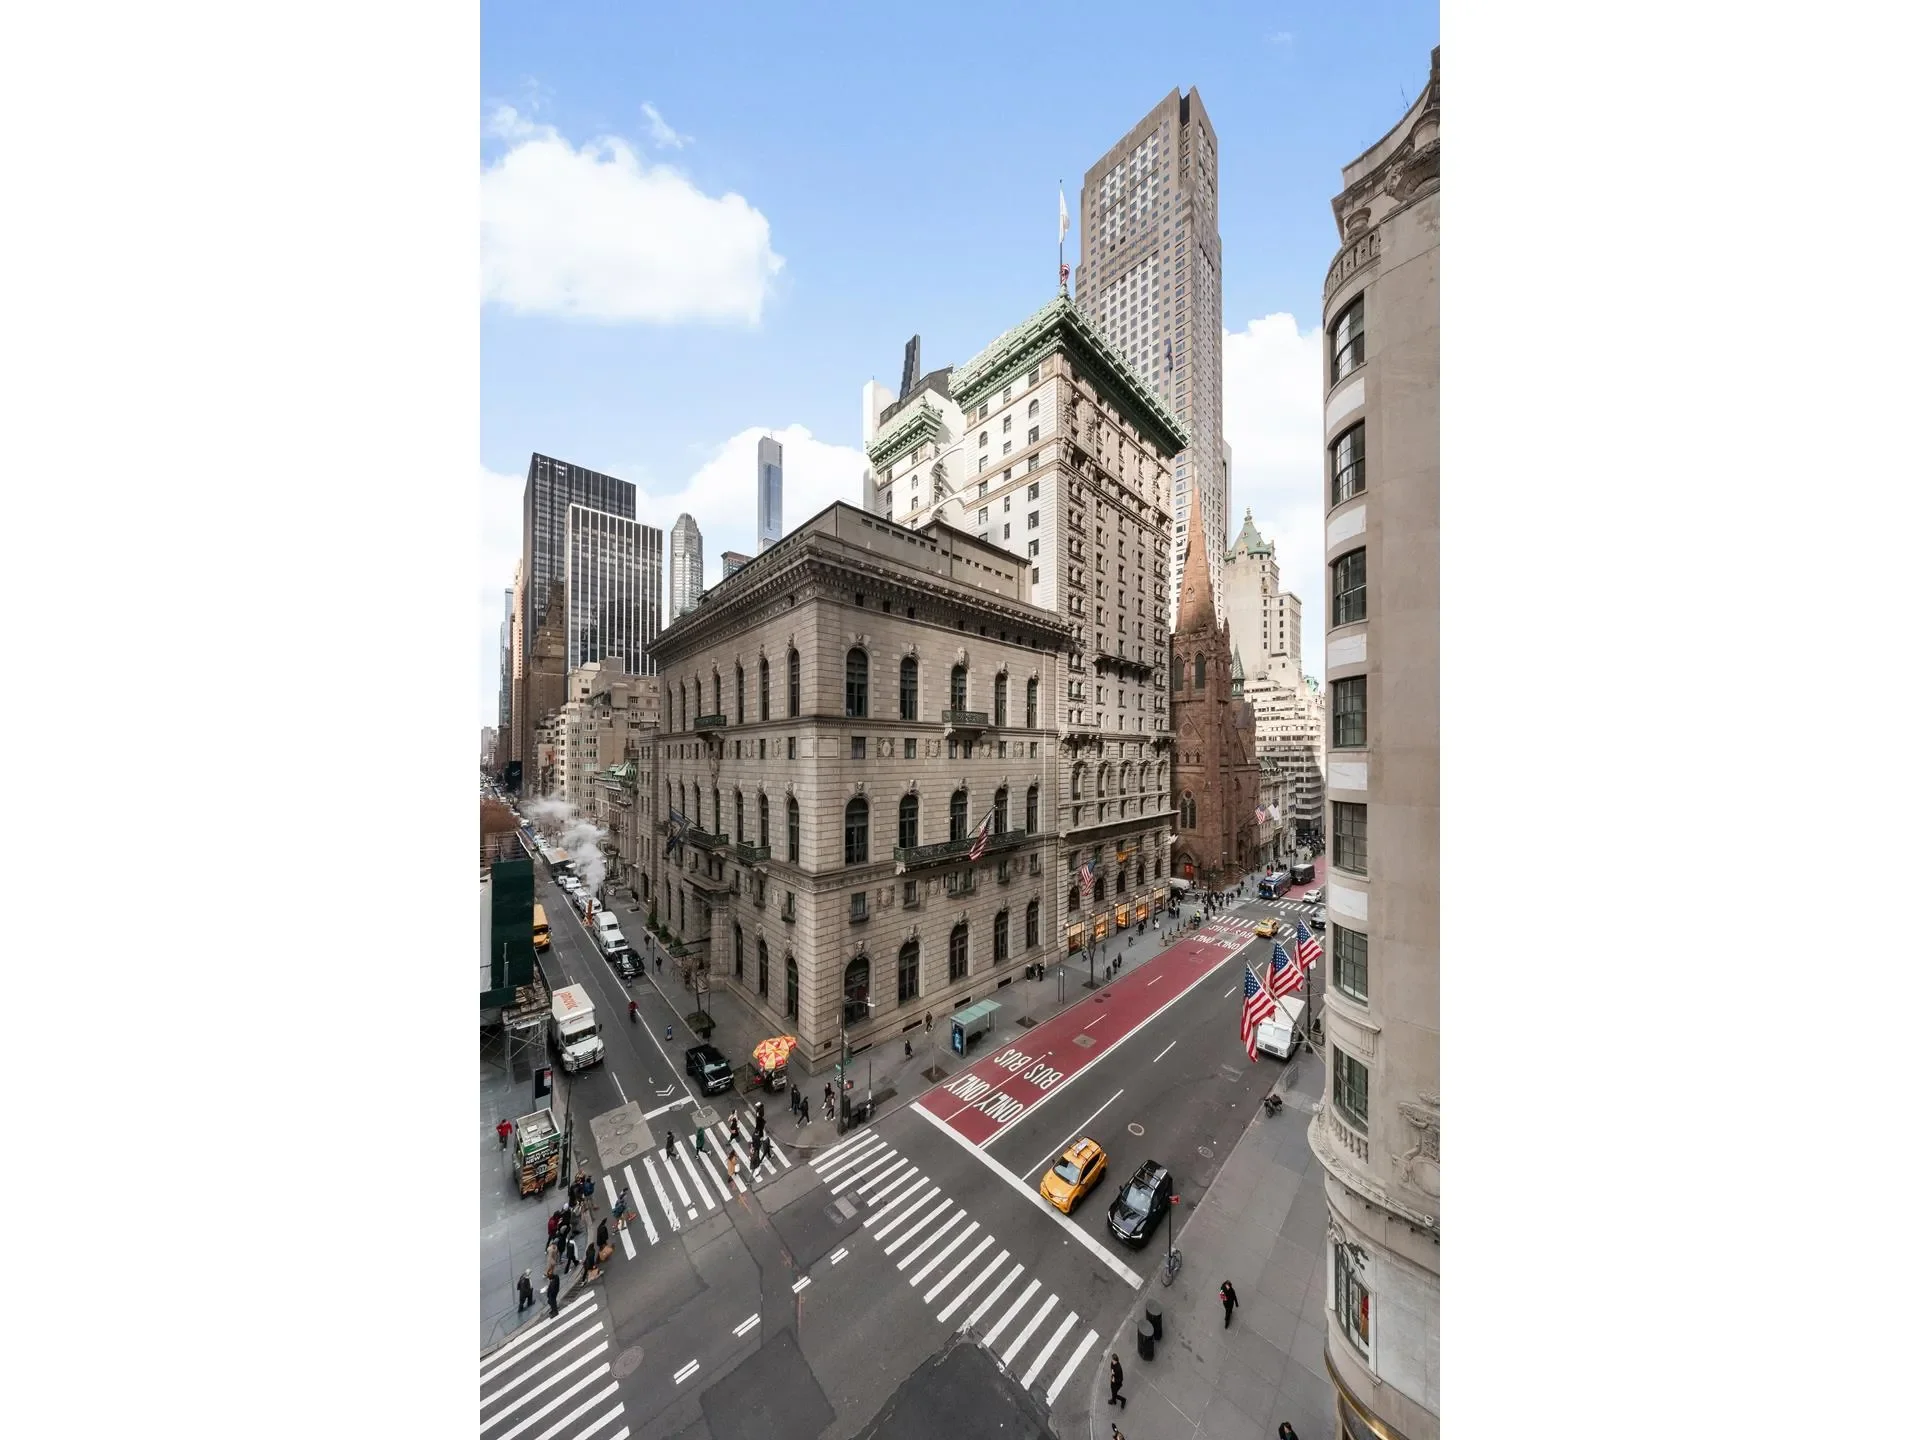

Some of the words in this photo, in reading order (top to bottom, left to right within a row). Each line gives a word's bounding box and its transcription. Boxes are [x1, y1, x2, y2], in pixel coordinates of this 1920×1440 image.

[994, 1049, 1033, 1072] BUS
[943, 1073, 991, 1101] ONLY
[1024, 1063, 1064, 1090] BUS
[973, 1092, 1024, 1123] ONLY
